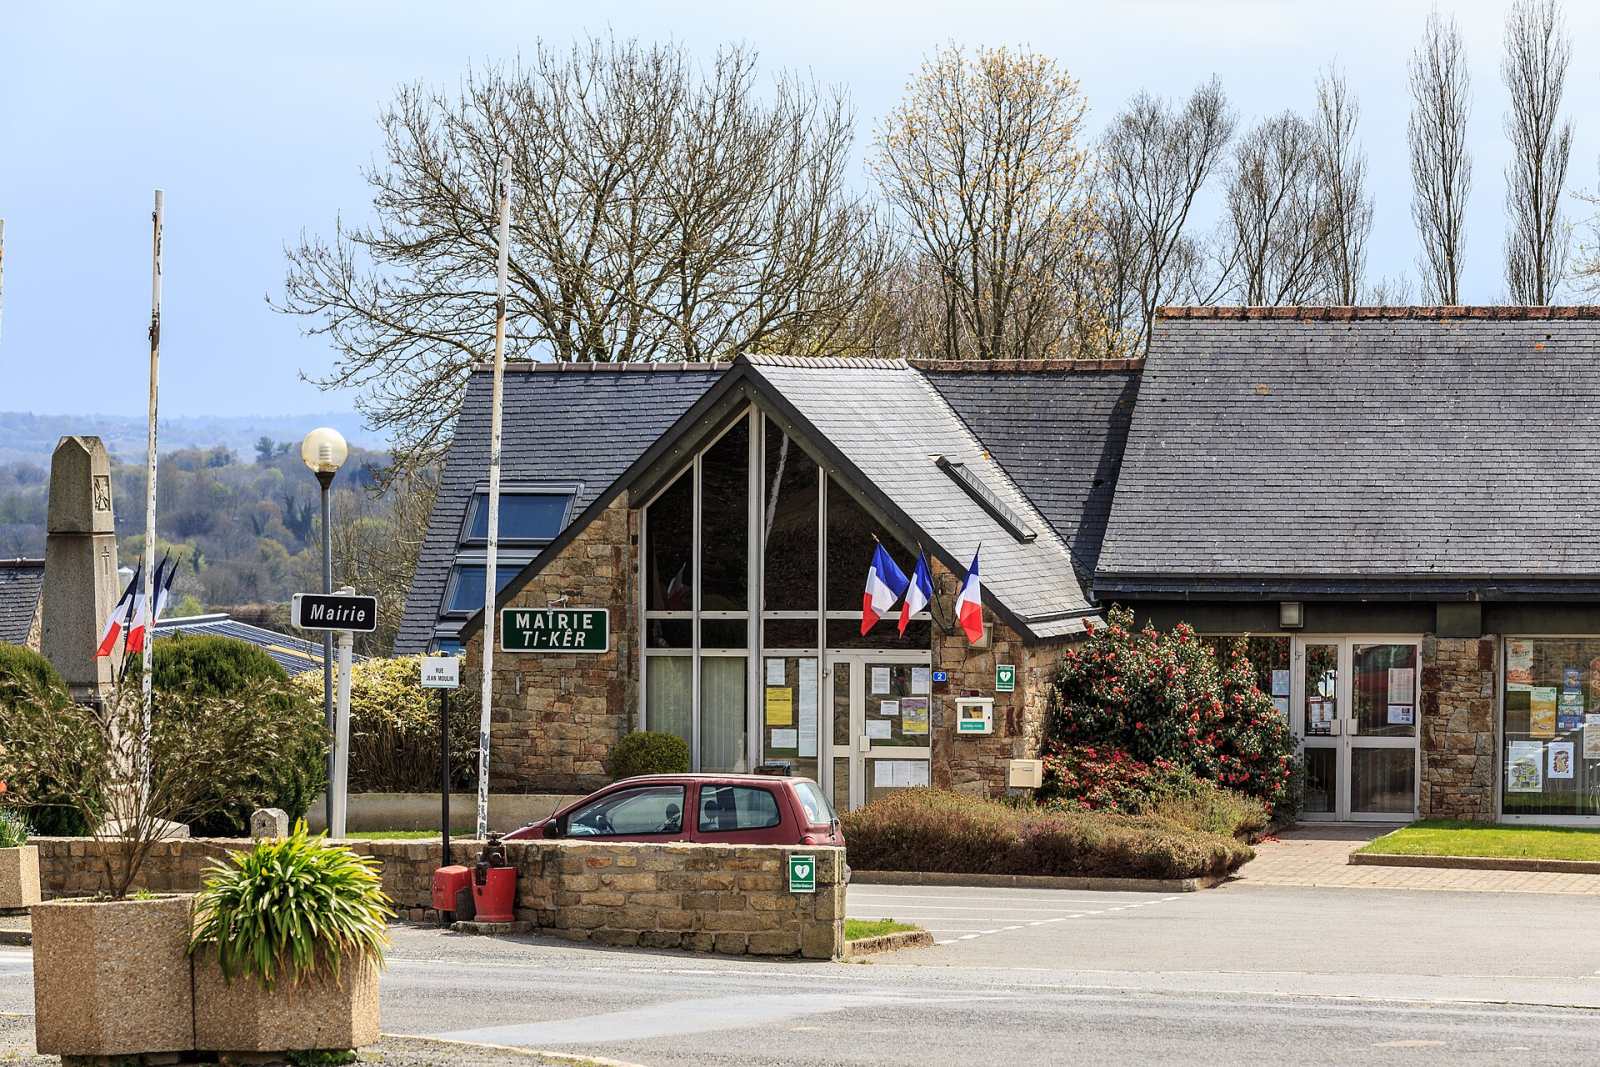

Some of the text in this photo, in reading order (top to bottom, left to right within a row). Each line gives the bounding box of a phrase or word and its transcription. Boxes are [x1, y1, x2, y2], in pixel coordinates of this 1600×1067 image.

[310, 604, 366, 622] Mairie
[516, 613, 592, 629] MAIRIE
[522, 628, 586, 646] TI-KÊR
